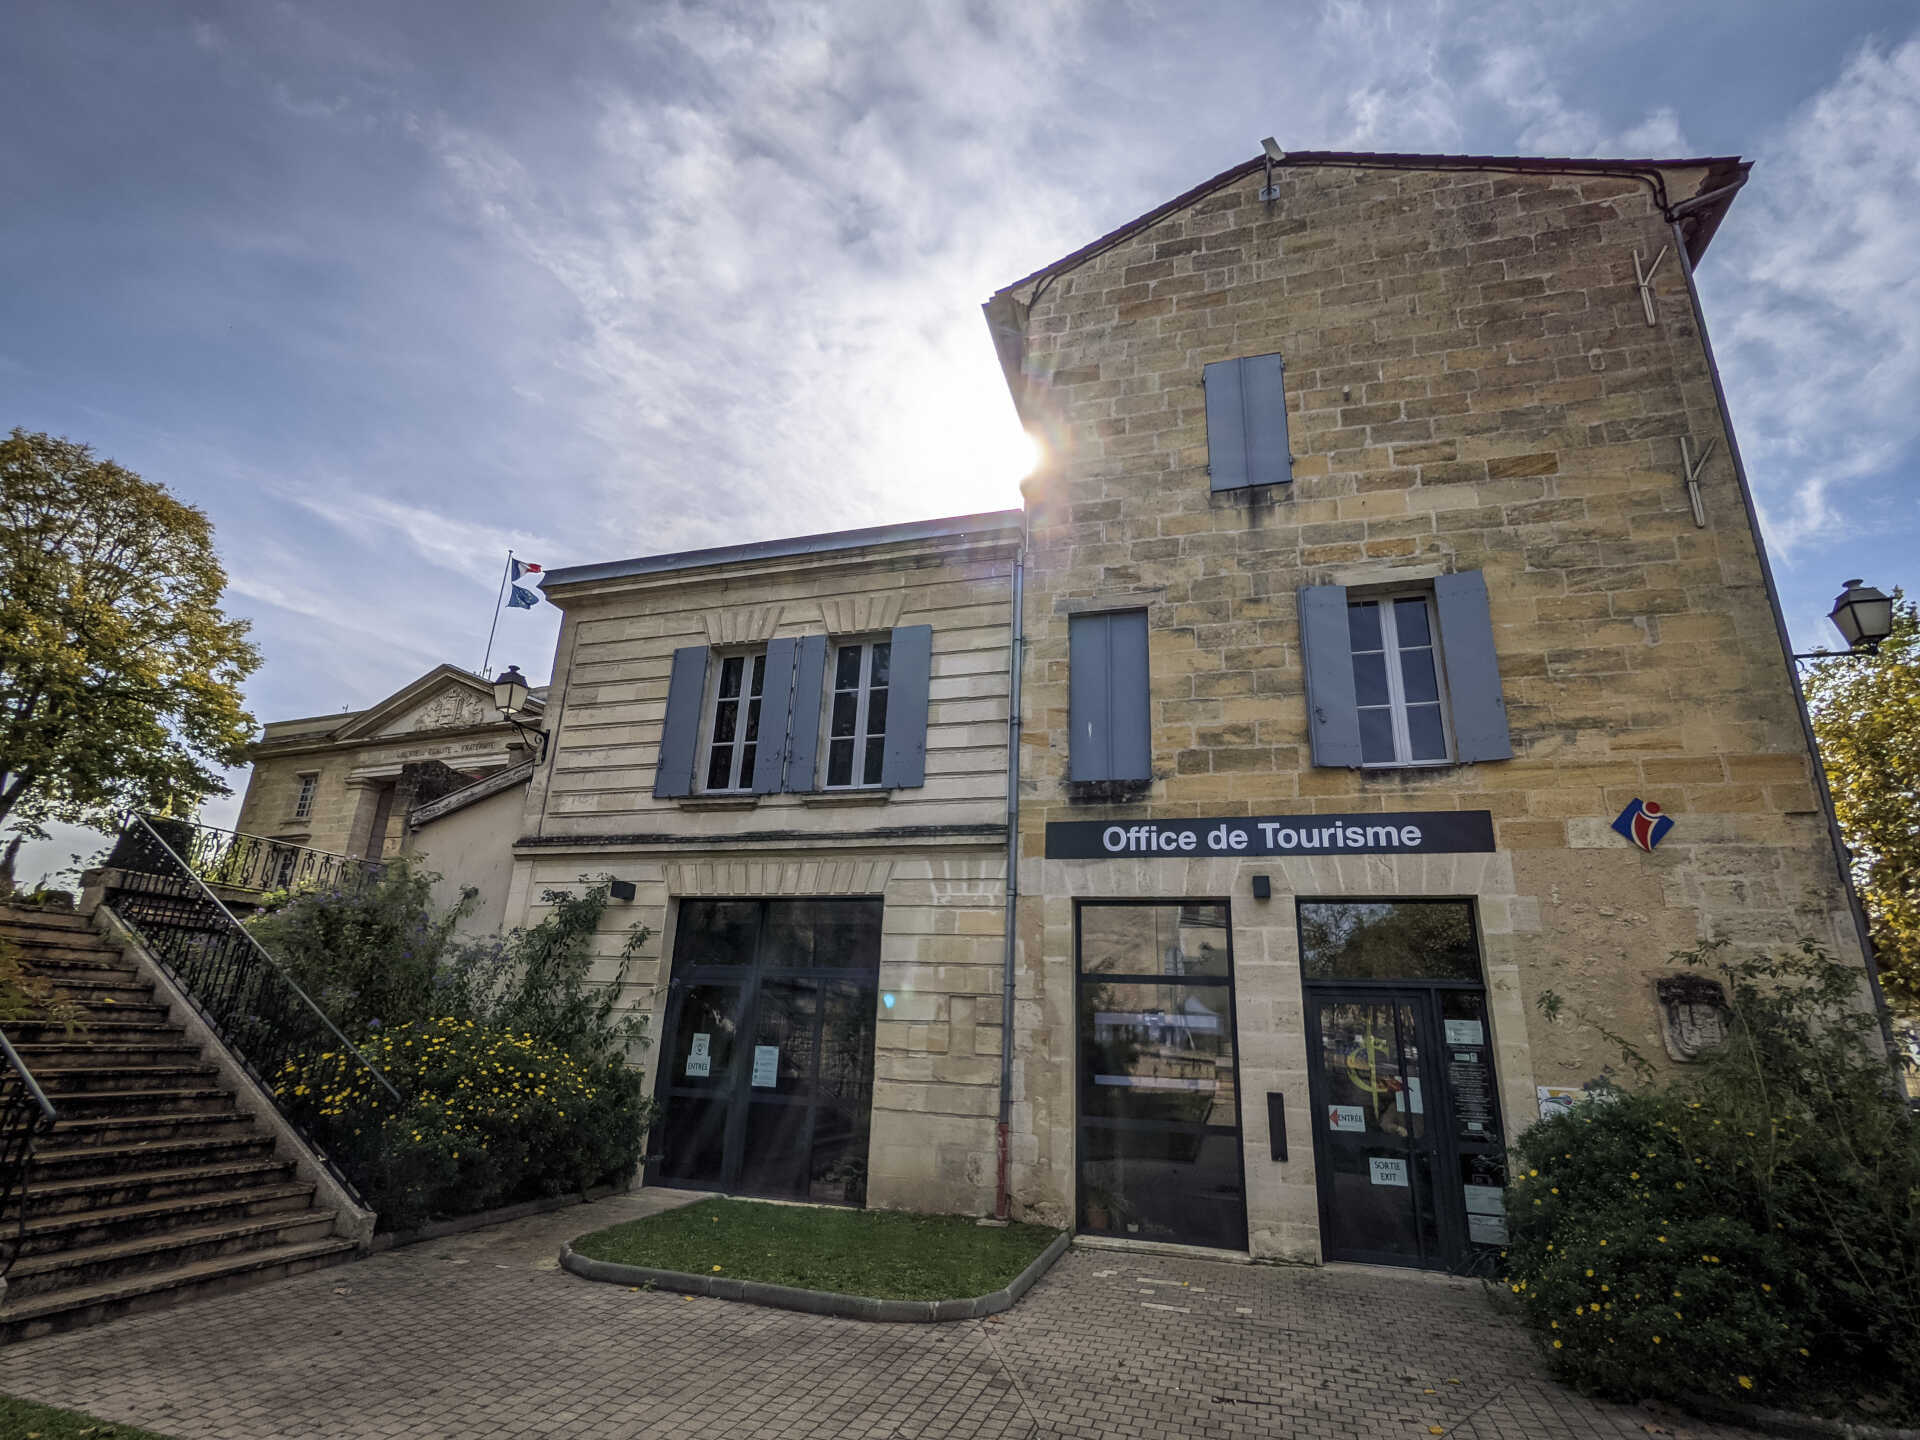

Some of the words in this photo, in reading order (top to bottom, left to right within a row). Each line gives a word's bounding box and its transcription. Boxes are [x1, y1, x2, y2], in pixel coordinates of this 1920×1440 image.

[1103, 826, 1197, 851] Office
[1207, 824, 1248, 850] de
[1258, 821, 1422, 849] Tourisme
[1374, 1161, 1400, 1171] SORTIE
[1380, 1172, 1396, 1181] EXIT
